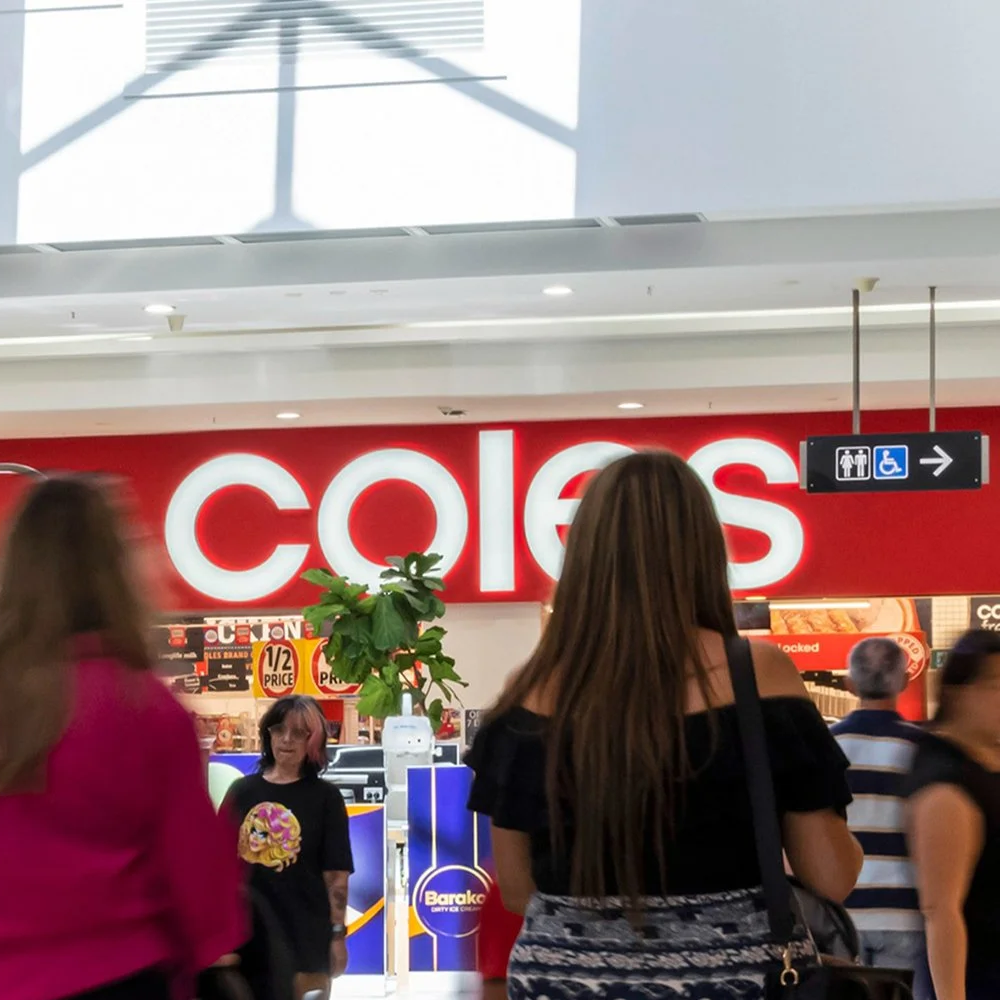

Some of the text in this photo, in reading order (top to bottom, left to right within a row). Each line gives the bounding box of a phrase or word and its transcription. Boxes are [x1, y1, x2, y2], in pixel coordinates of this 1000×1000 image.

[165, 430, 804, 602] coles
[777, 643, 820, 653] ocked
[265, 646, 292, 672] 1/2
[264, 673, 293, 687] PRICE
